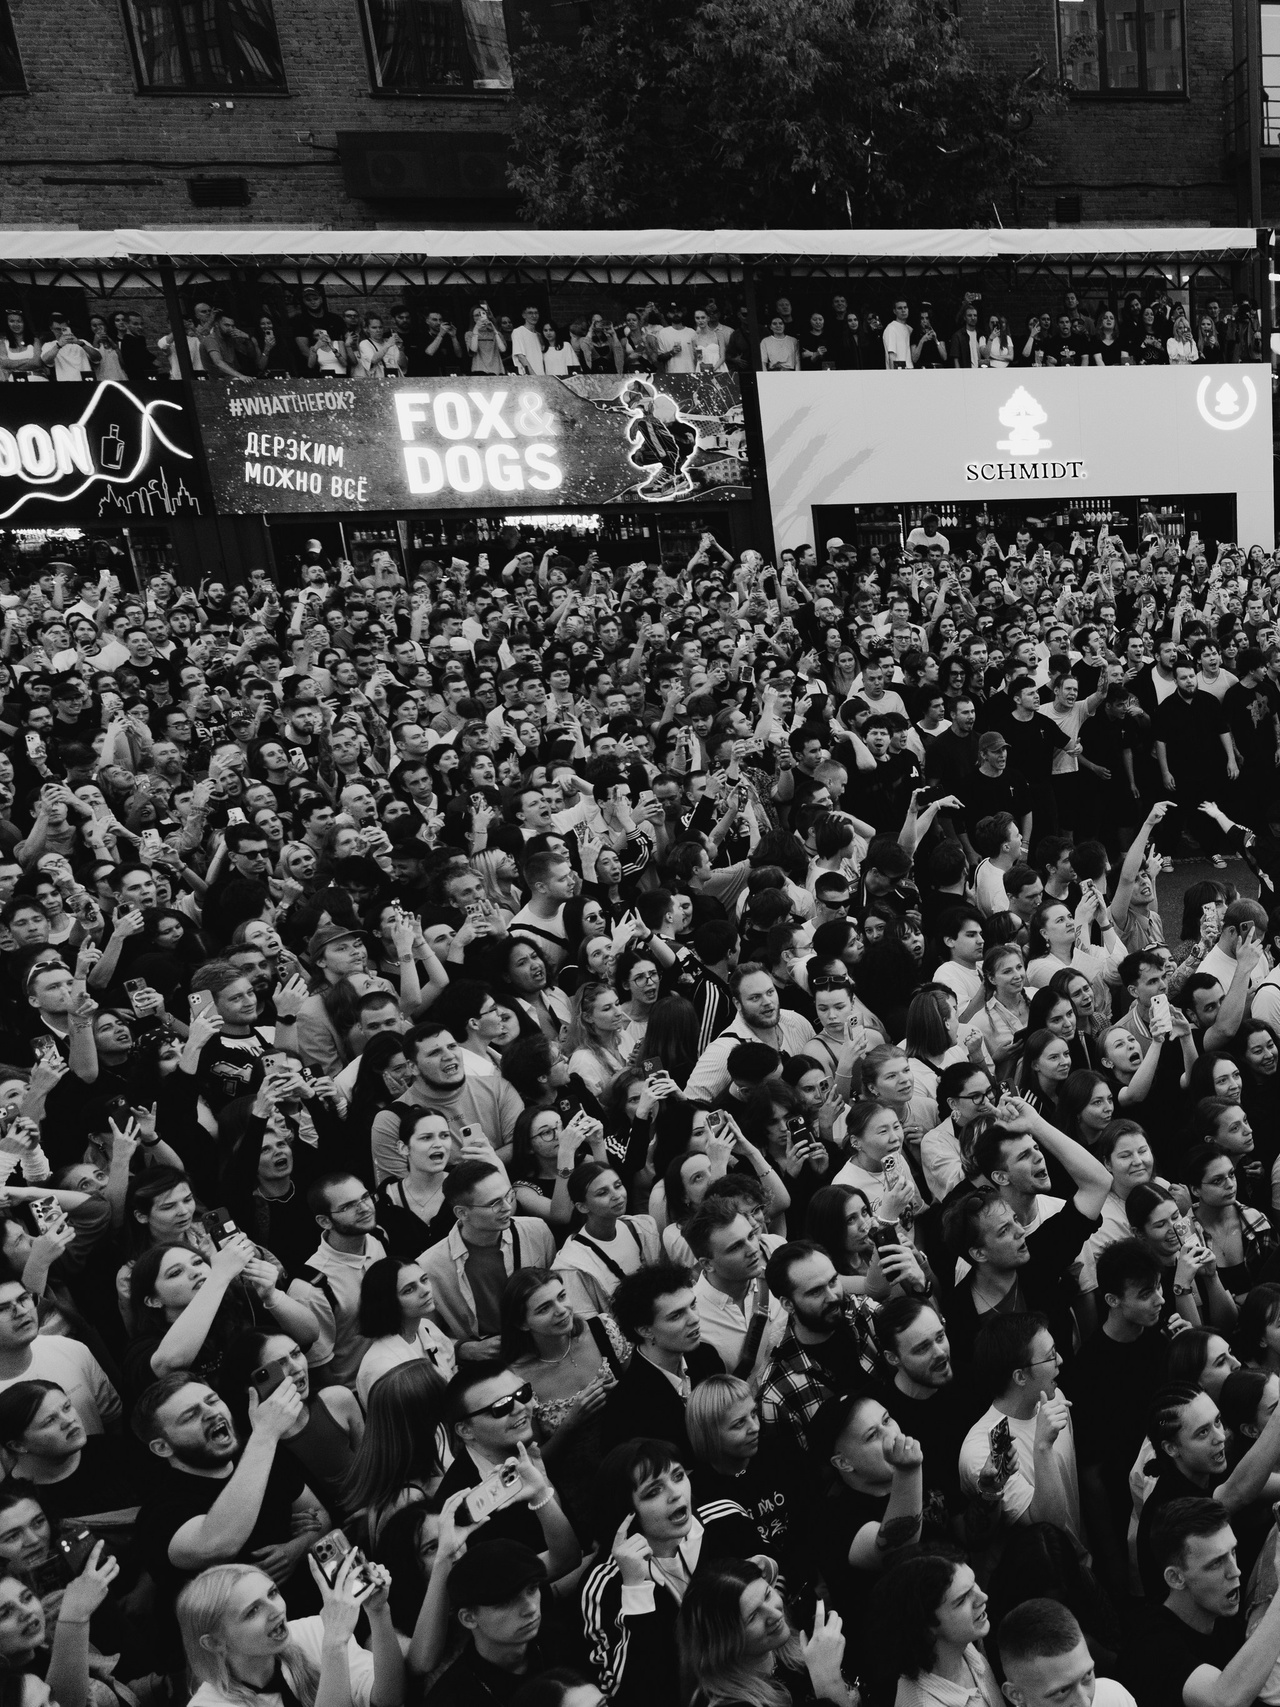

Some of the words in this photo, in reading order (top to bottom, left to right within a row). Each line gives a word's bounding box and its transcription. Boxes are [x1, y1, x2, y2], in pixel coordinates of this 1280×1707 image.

[229, 391, 356, 417] #WHATTHEFOX?
[394, 391, 558, 441] FOX&
[244, 432, 344, 468] ДЕРЗКИМ
[403, 443, 563, 494] DOGS
[245, 461, 322, 494] МОЖНО
[331, 476, 368, 502] ВСЁ
